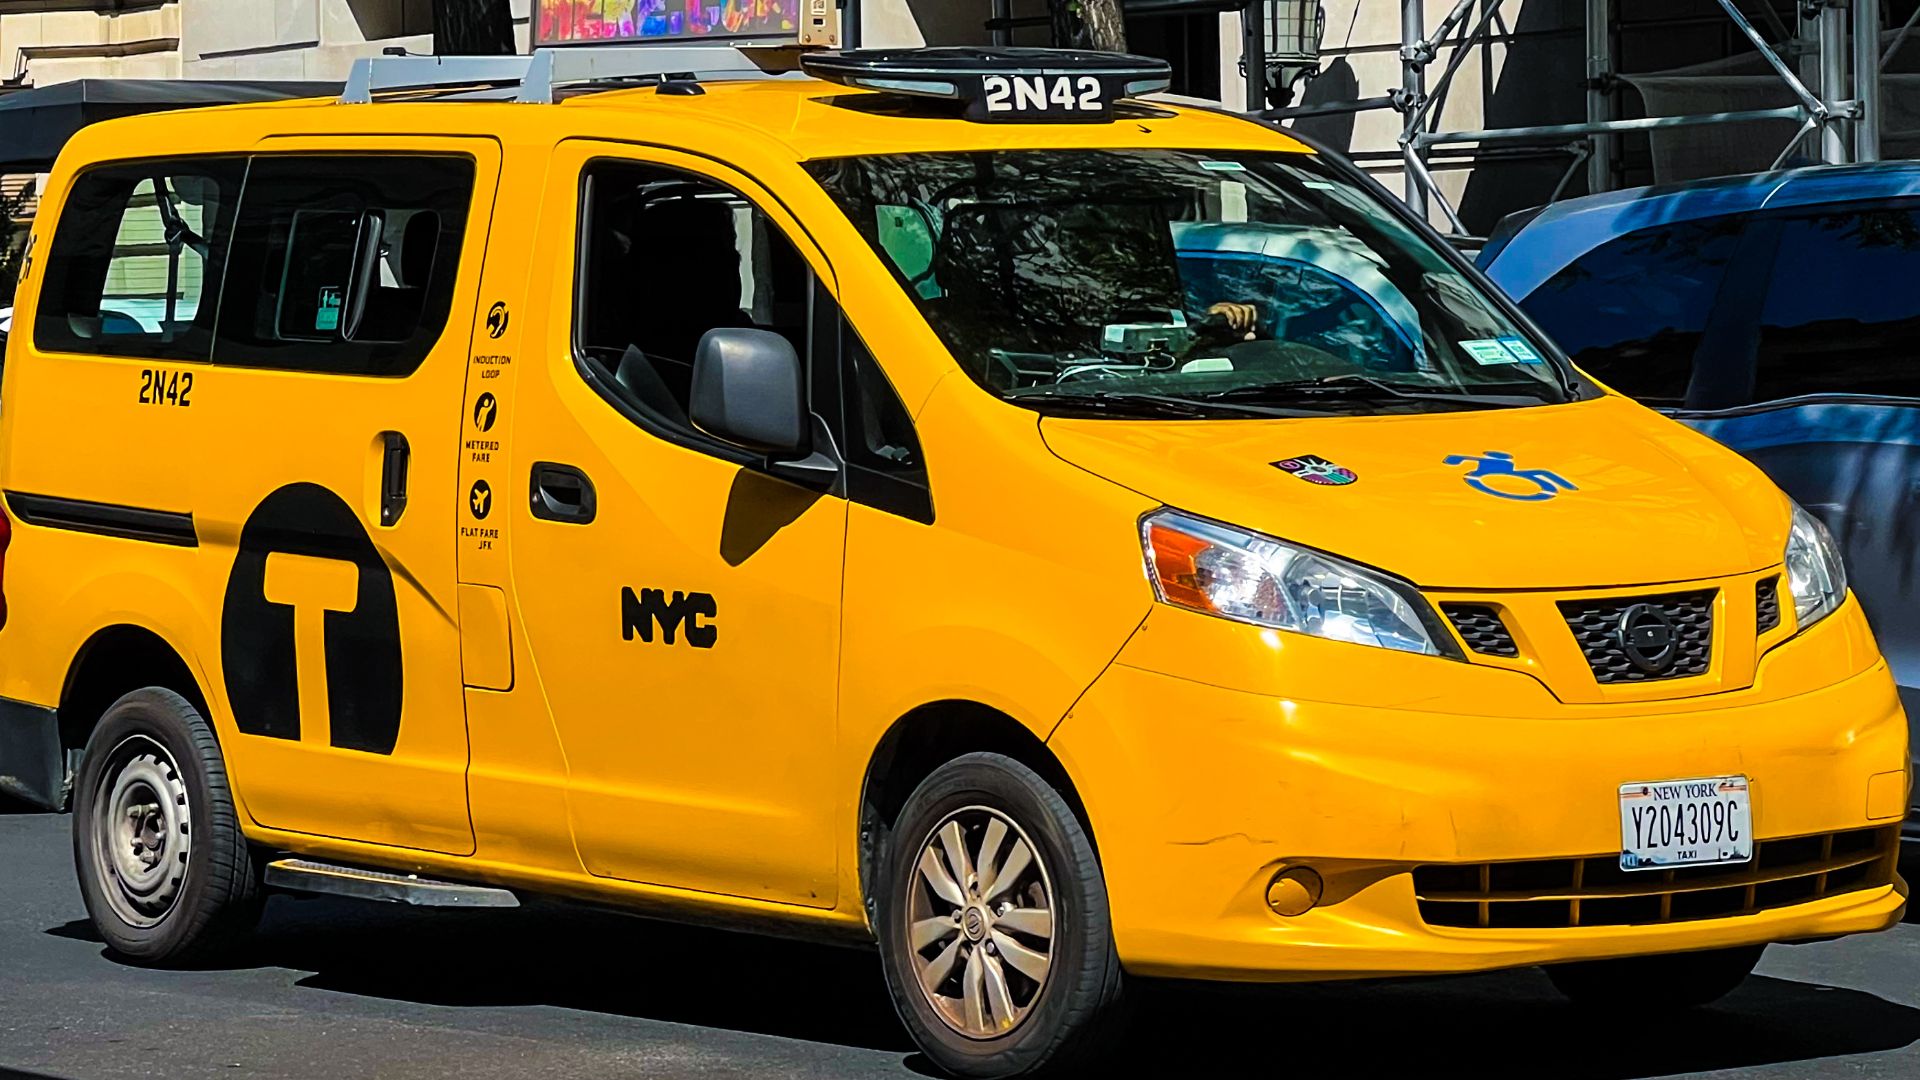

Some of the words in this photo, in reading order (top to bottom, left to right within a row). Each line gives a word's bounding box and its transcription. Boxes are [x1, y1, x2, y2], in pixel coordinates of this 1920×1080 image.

[983, 76, 1103, 112] 2N42
[473, 355, 512, 365] INDUCTION
[481, 369, 500, 379] LOOP
[139, 369, 193, 407] 2N42
[465, 440, 500, 451] METERED
[472, 453, 490, 463] FARE
[460, 527, 478, 537] FLAT
[479, 529, 499, 539] FARE
[478, 541, 492, 550] JFK
[621, 586, 718, 649] NYC
[1653, 785, 1681, 801] NEW
[1684, 783, 1718, 799] YORK
[1631, 800, 1739, 850] Y204309C
[1677, 850, 1697, 860] TAXI
